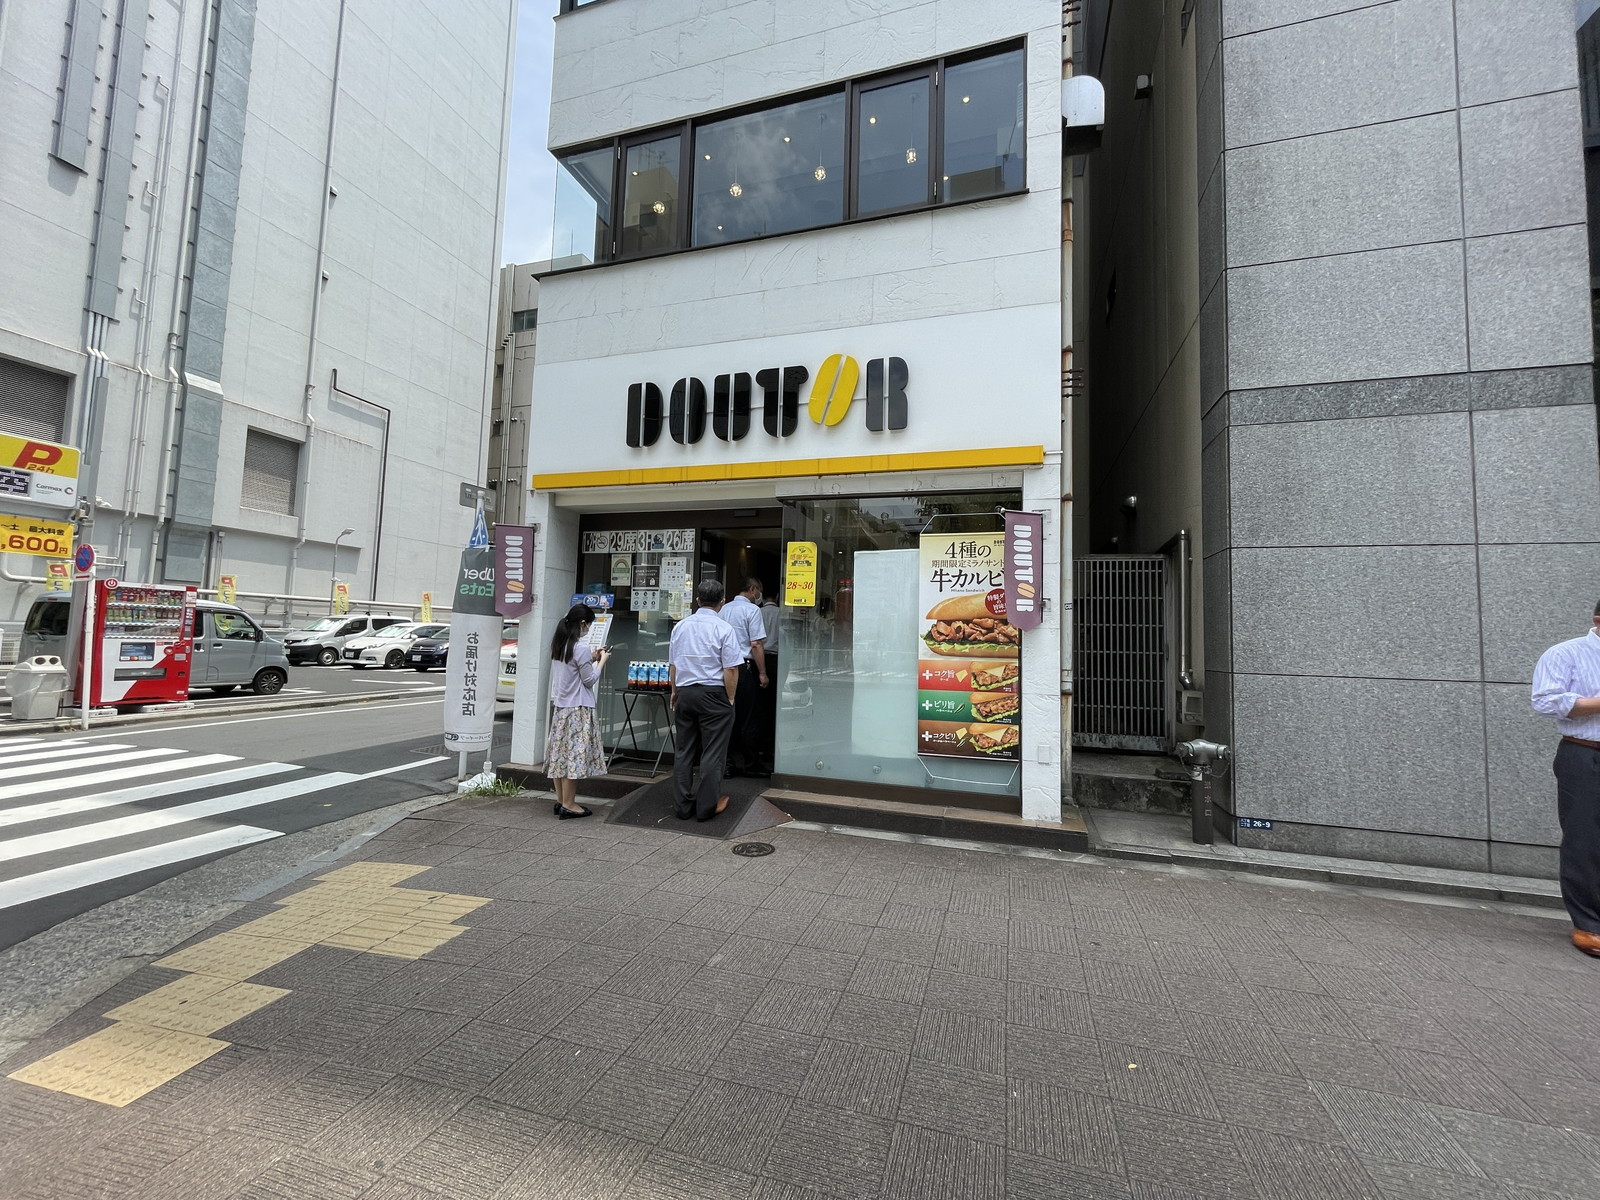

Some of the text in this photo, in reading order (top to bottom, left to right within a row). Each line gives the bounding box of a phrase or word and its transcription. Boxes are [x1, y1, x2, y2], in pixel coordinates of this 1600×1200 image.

[626, 353, 909, 448] DOUTOR
[12, 441, 63, 469] P
[29, 525, 65, 536] 最大料金
[610, 532, 637, 552] 29席
[666, 529, 695, 551] 26席
[945, 541, 991, 559] 4種の
[505, 535, 525, 603] DOUTOR
[930, 568, 1004, 592] 牛カルビ
[1013, 524, 1035, 612] DOUTOR
